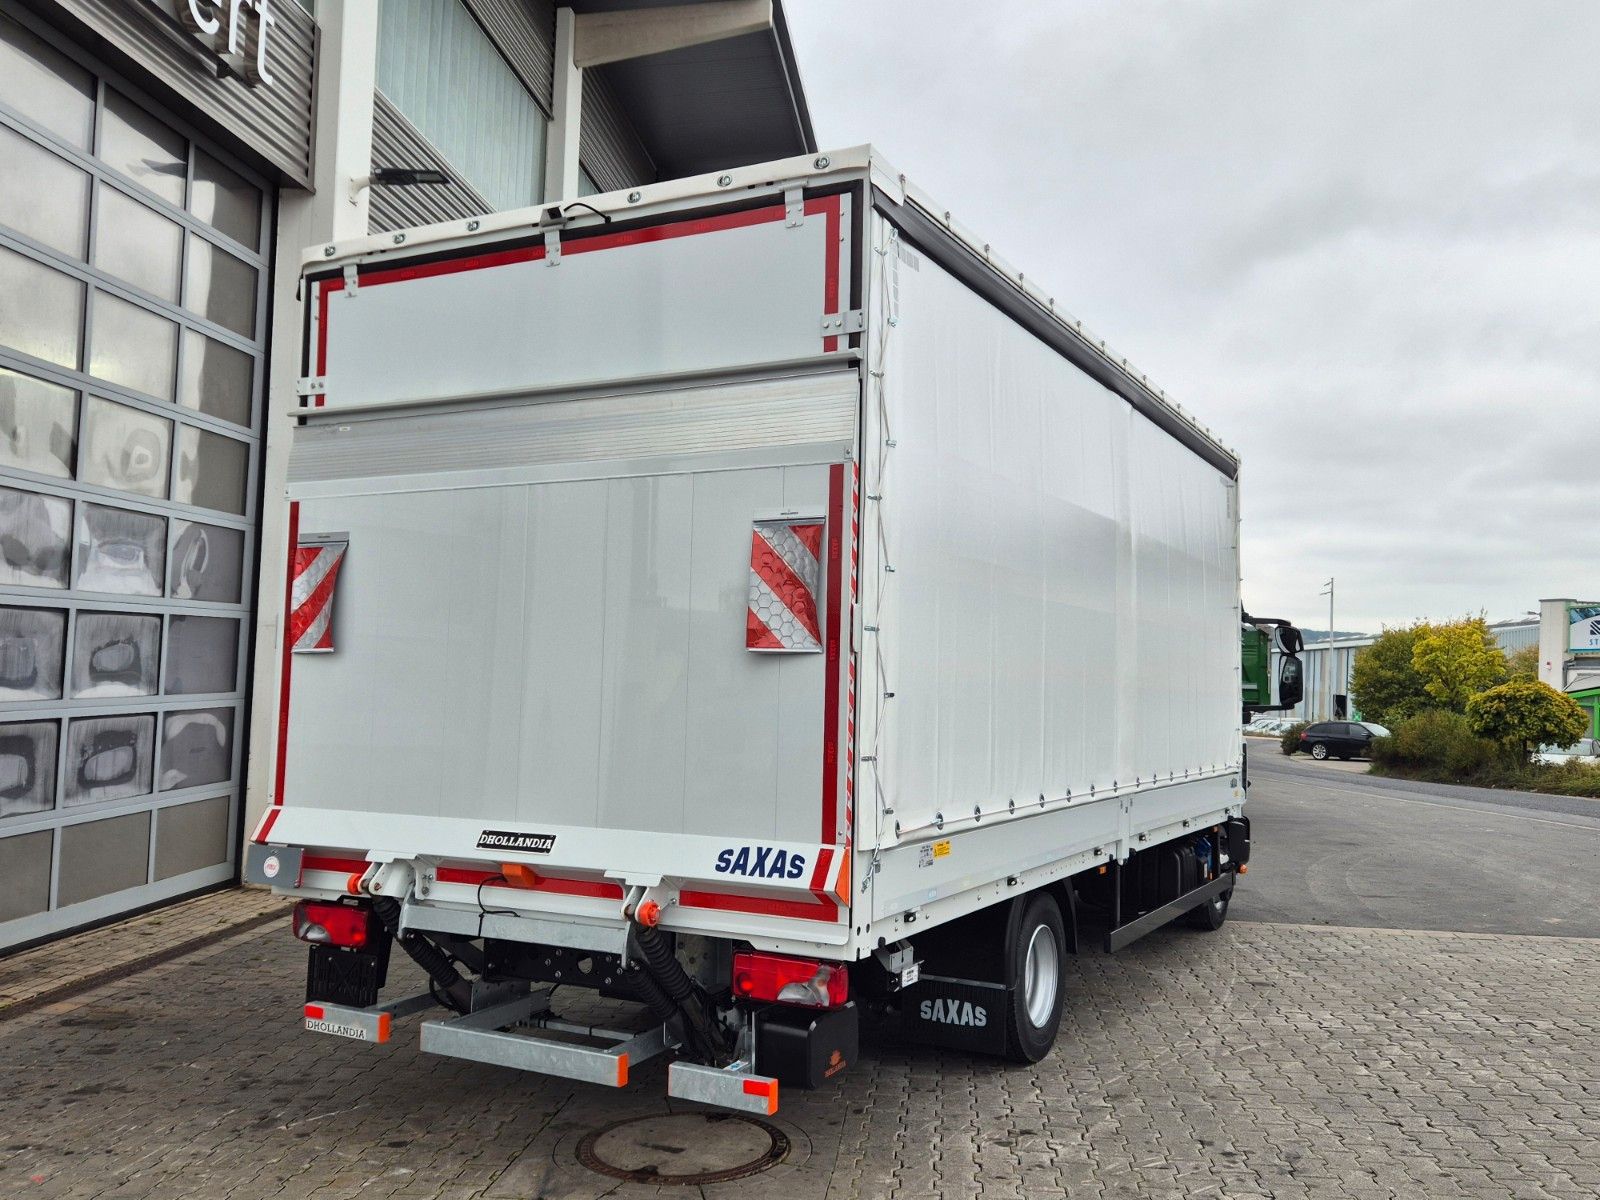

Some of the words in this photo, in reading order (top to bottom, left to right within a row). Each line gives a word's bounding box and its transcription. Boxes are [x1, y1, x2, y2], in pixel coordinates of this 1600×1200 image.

[479, 834, 553, 849] DHOLLANDIA
[715, 846, 806, 879] SAXAS
[920, 998, 987, 1027] SAXAS
[307, 1020, 366, 1039] DHOLLANDIA
